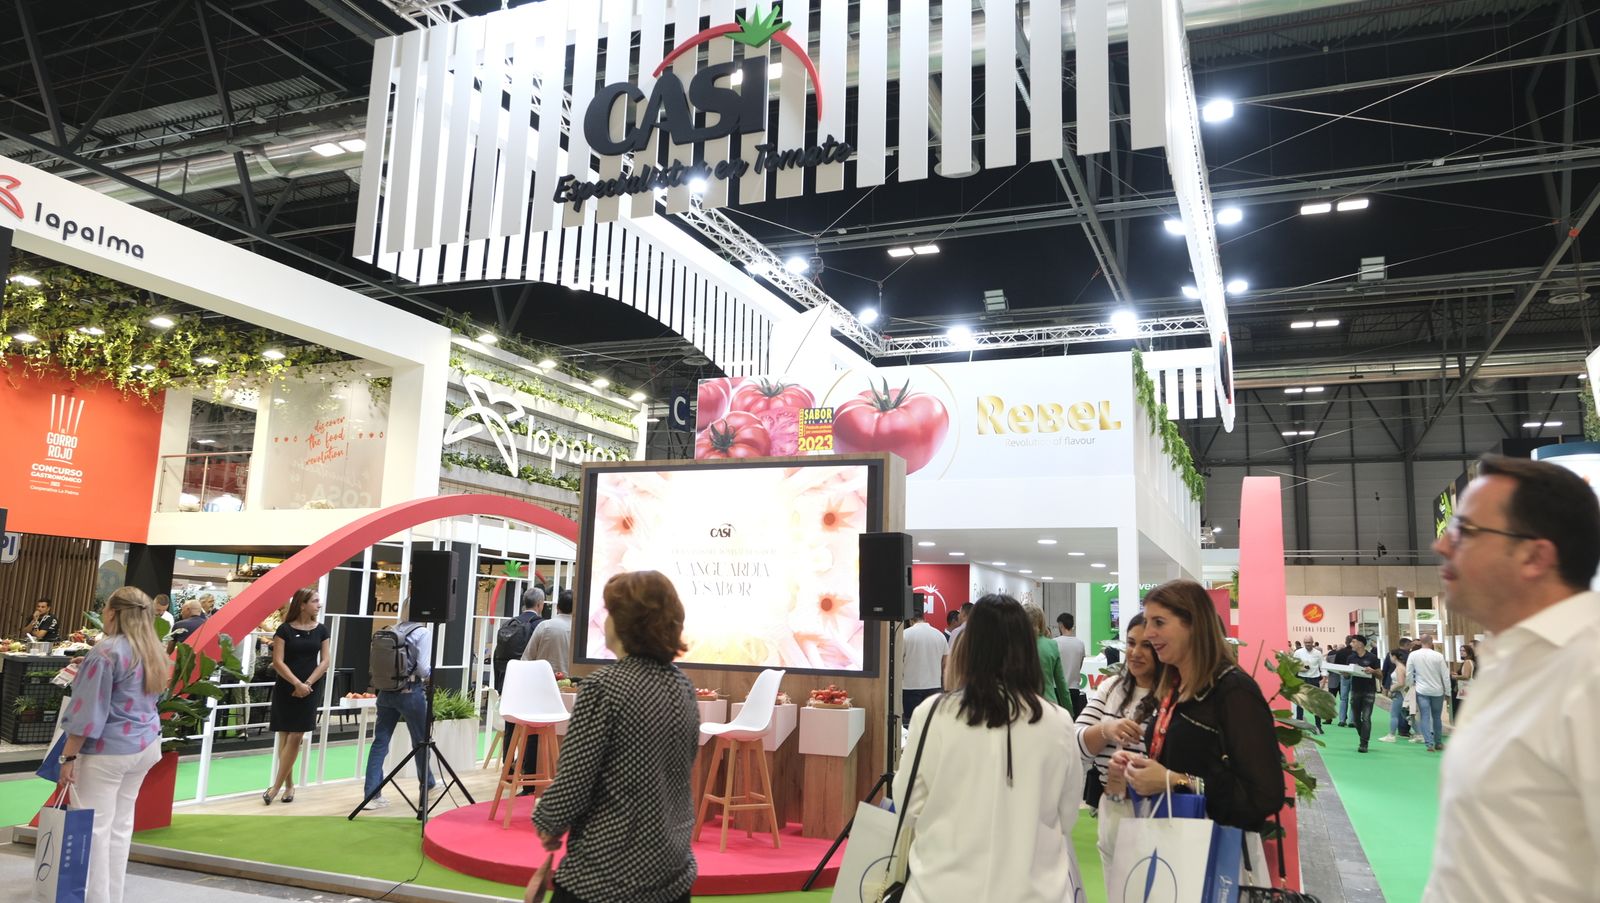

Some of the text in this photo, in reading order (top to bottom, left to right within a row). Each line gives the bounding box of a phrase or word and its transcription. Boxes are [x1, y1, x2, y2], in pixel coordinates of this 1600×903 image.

[583, 55, 769, 156] CASI
[754, 134, 854, 175] Tomate
[34, 202, 145, 260] lapalma
[674, 396, 686, 425] C
[804, 408, 832, 420] SABOR
[47, 432, 78, 448] GORRO
[798, 434, 833, 451] 2023
[1064, 436, 1096, 446] flavour
[48, 445, 73, 460] ROJO
[31, 463, 83, 477] CONCURSO
[710, 528, 731, 538] CASI
